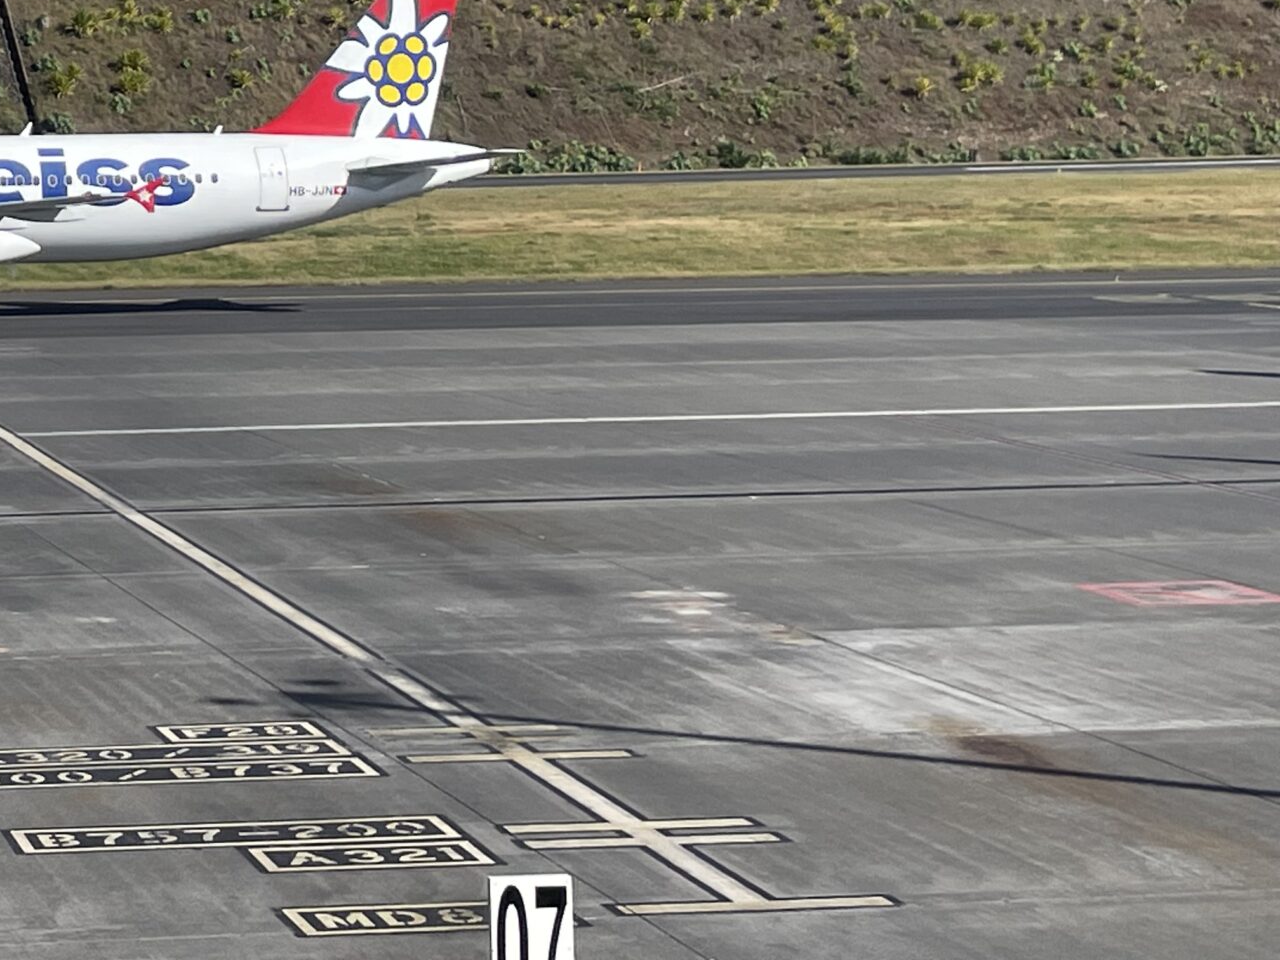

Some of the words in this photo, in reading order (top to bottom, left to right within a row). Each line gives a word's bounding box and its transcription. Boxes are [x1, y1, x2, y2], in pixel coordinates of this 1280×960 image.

[289, 186, 333, 197] HB-JJN
[181, 724, 298, 738] F28
[217, 742, 320, 757] 319
[169, 762, 343, 779] B737
[36, 821, 426, 848] B757-200
[290, 845, 465, 866] A321
[314, 908, 484, 929] MD8
[496, 885, 568, 960] 07
